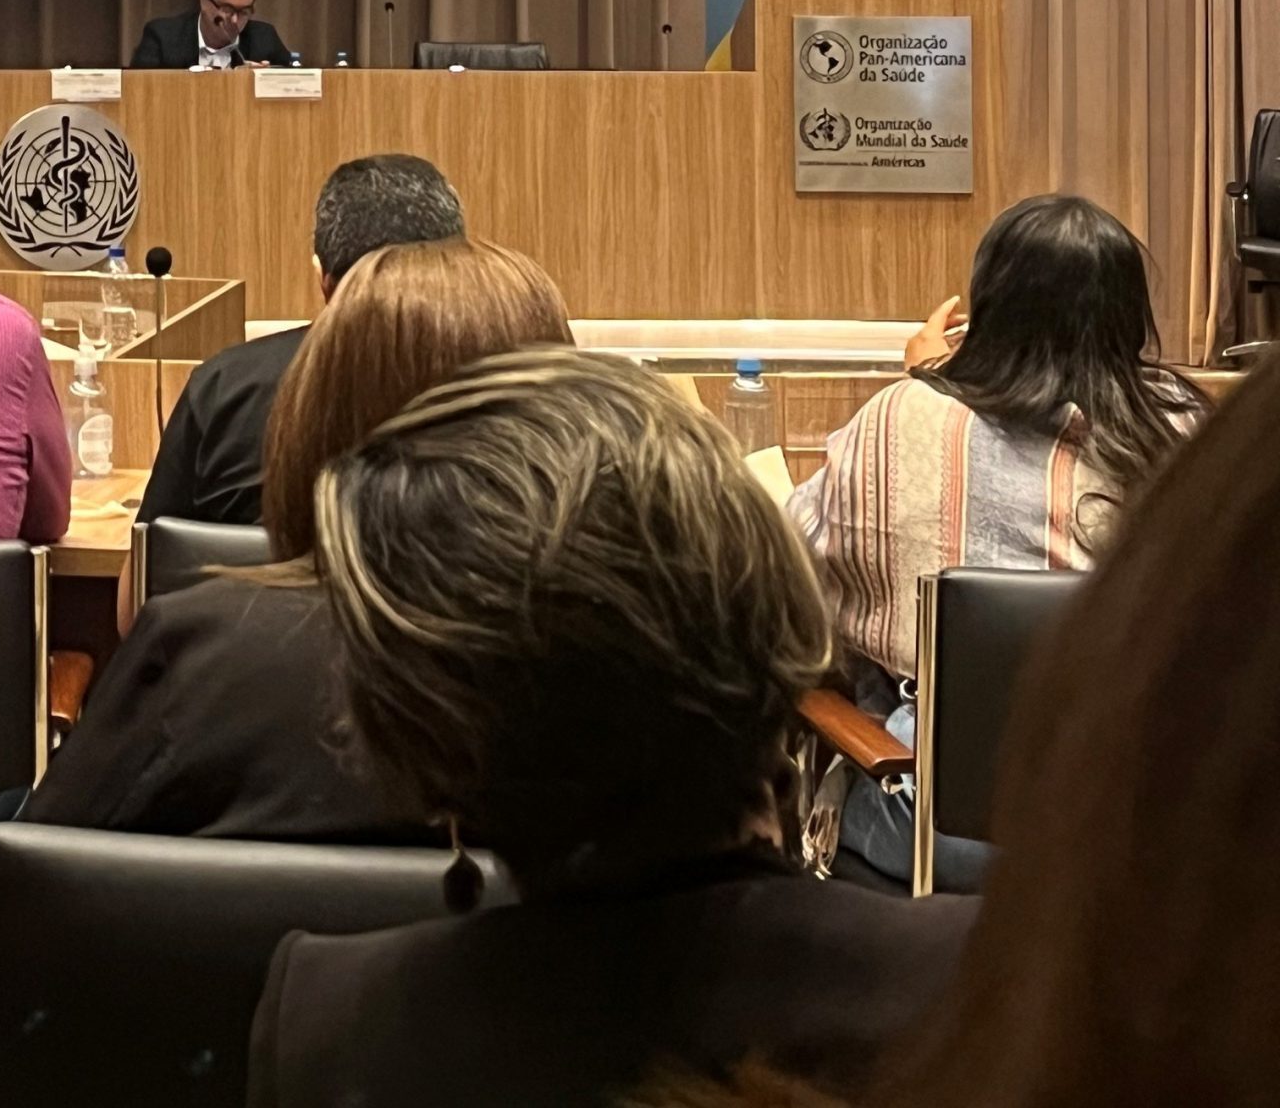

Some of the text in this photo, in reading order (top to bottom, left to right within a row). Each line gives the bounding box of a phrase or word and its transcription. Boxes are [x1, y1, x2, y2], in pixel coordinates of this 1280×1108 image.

[858, 34, 948, 53] Organização
[858, 52, 967, 67] Pan-Americana
[858, 68, 926, 83] da Saúde
[854, 116, 933, 134] Organização
[856, 134, 907, 148] Mundial
[911, 133, 927, 148] da
